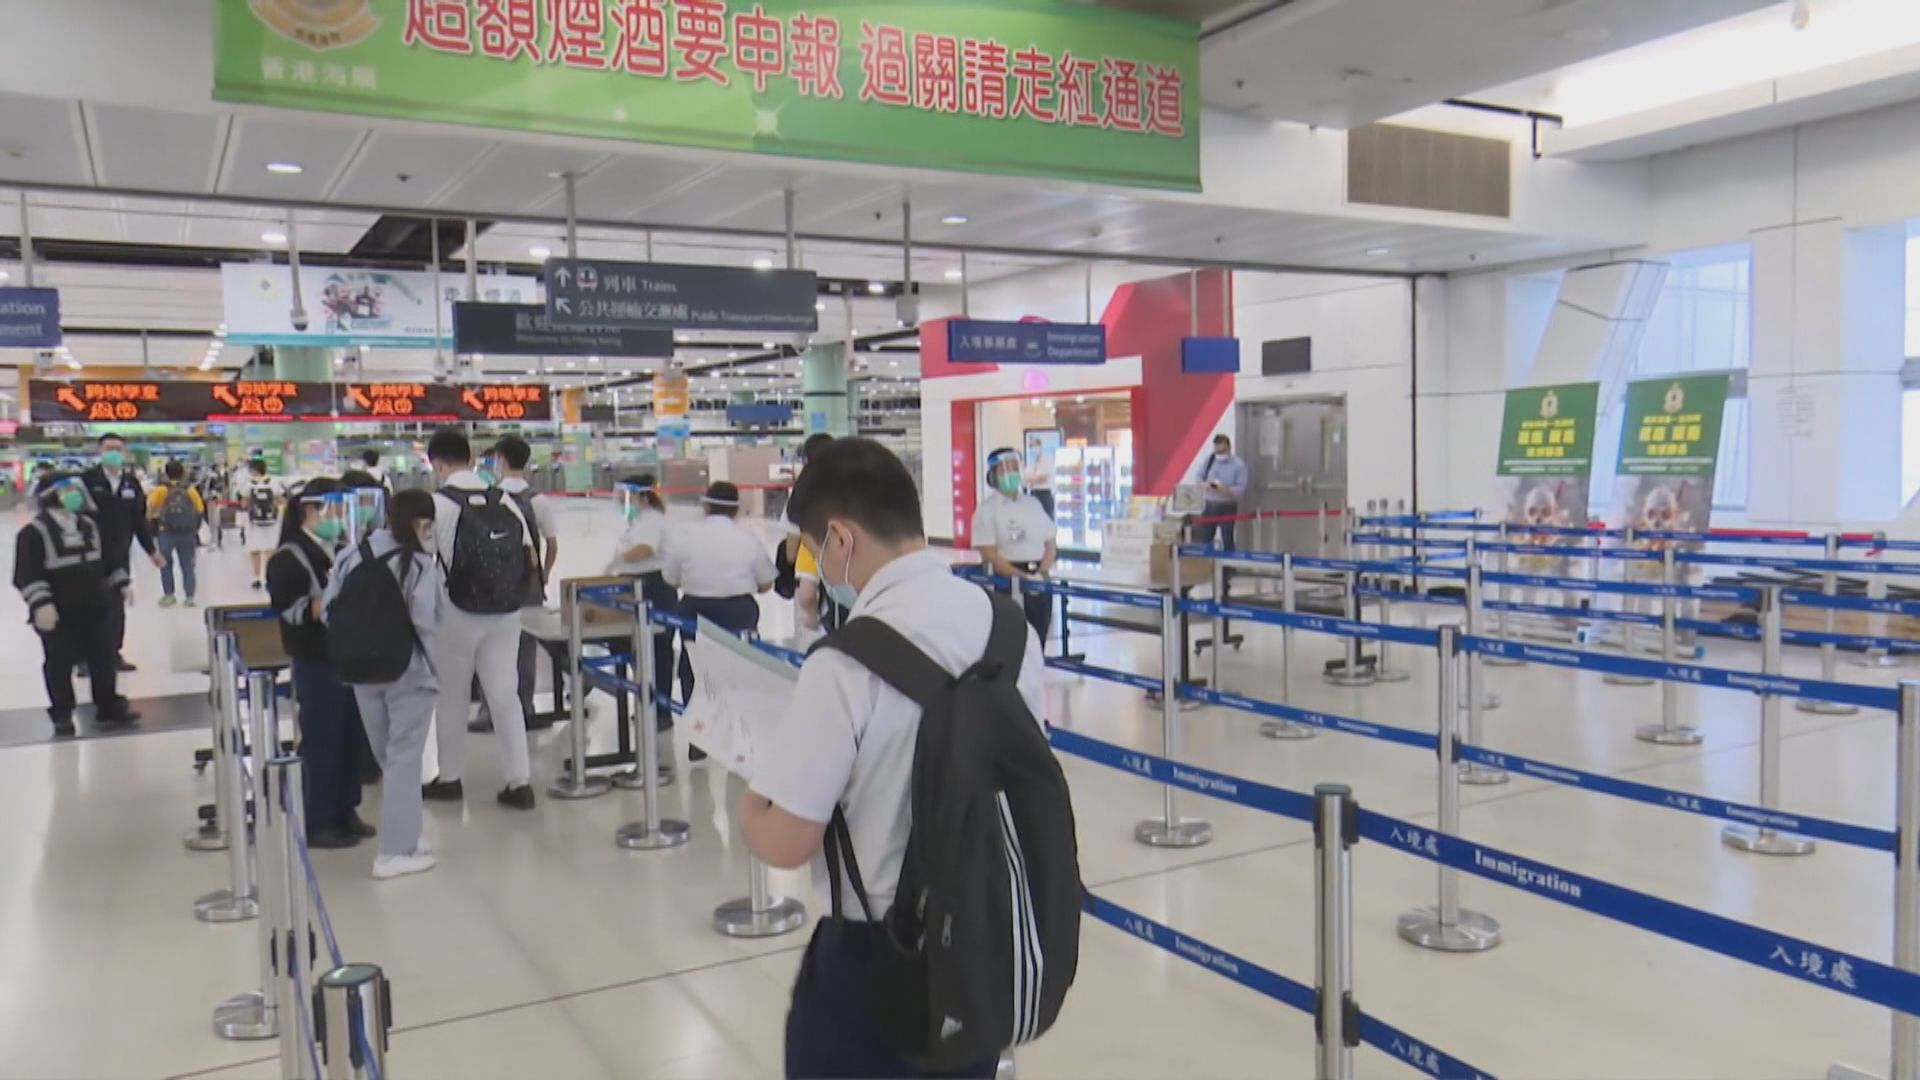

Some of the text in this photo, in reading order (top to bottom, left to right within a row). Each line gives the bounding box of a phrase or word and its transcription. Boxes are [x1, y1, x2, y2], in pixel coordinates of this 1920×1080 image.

[401, 0, 1186, 138] 超額煙酒要申報 過關請走紅通道
[1173, 765, 1238, 795] Immigration
[1390, 826, 1856, 989] 入境處 Immigration 入境處
[1175, 935, 1239, 975] Immigration
[1390, 1035, 1441, 1075] 入境處
